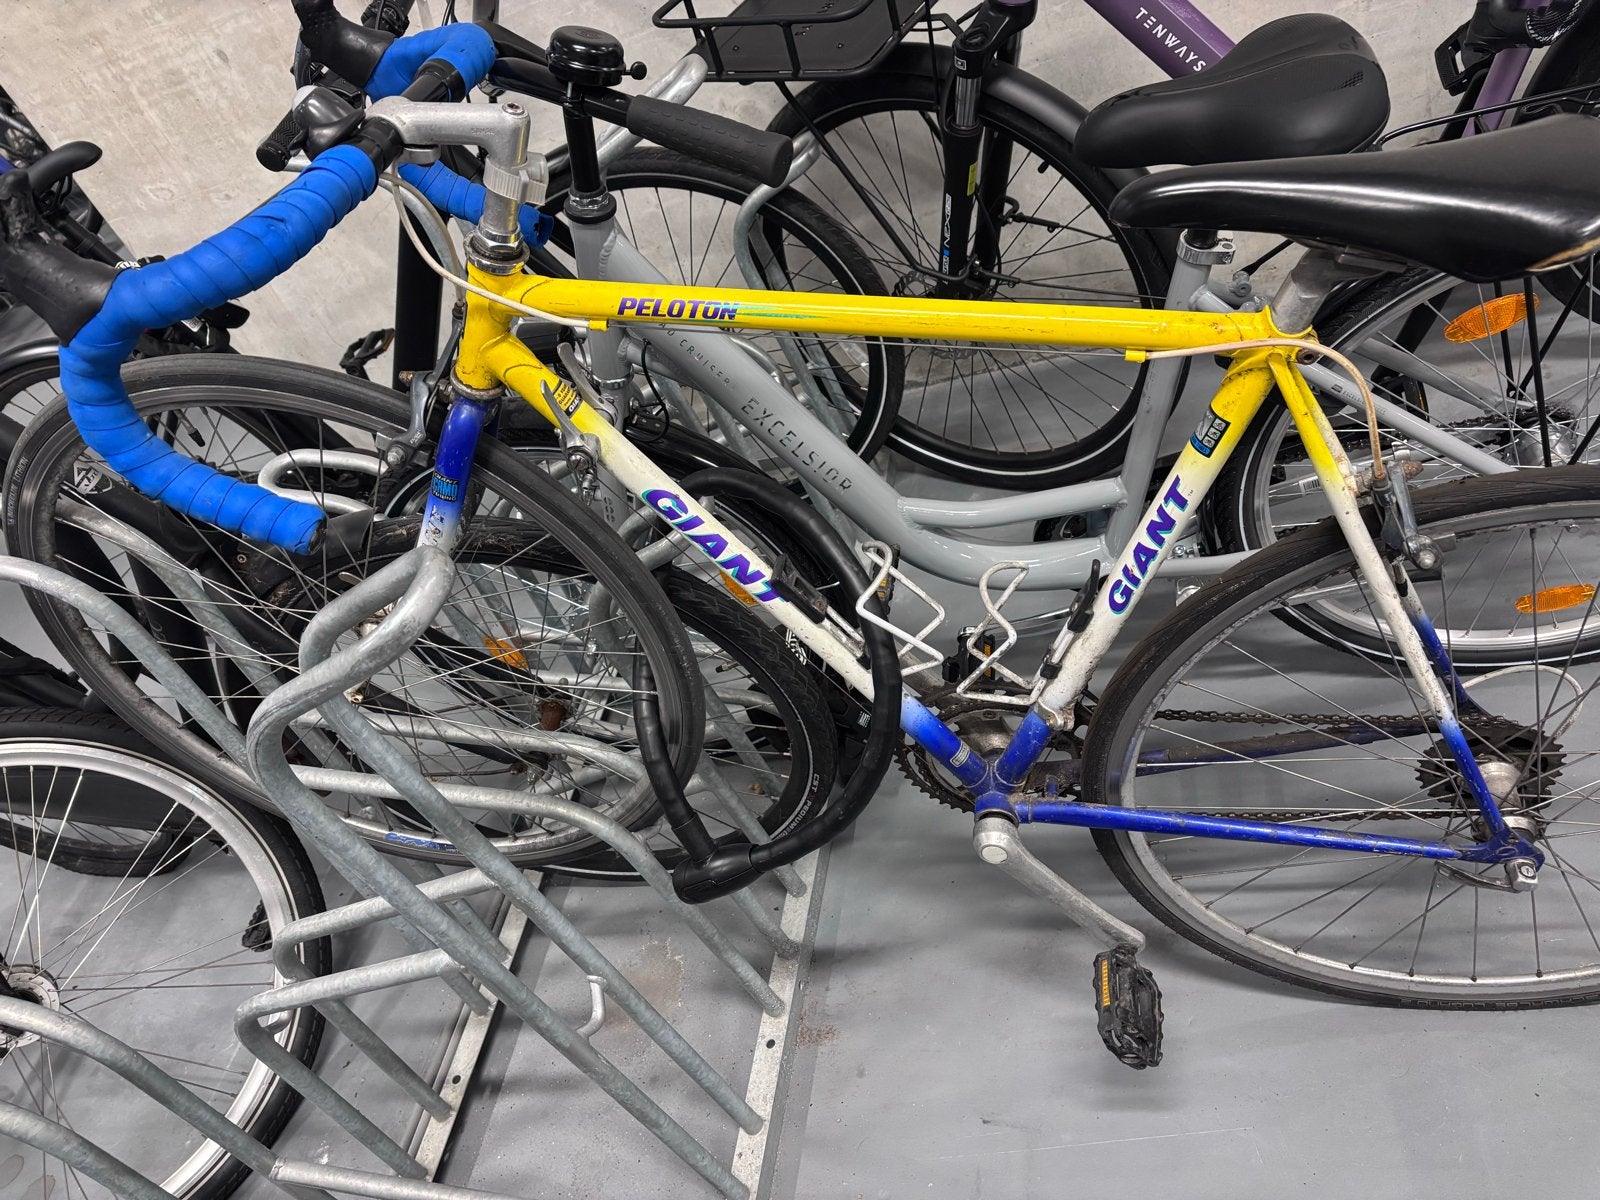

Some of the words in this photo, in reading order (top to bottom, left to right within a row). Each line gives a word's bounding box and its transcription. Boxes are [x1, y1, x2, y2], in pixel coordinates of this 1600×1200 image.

[1135, 7, 1207, 72] TENWAYS
[617, 297, 740, 321] PELOTON
[741, 398, 853, 495] EXCELSIOR
[641, 489, 783, 603] GIANT
[1108, 474, 1189, 615] GIANT
[811, 773, 820, 793] CST
